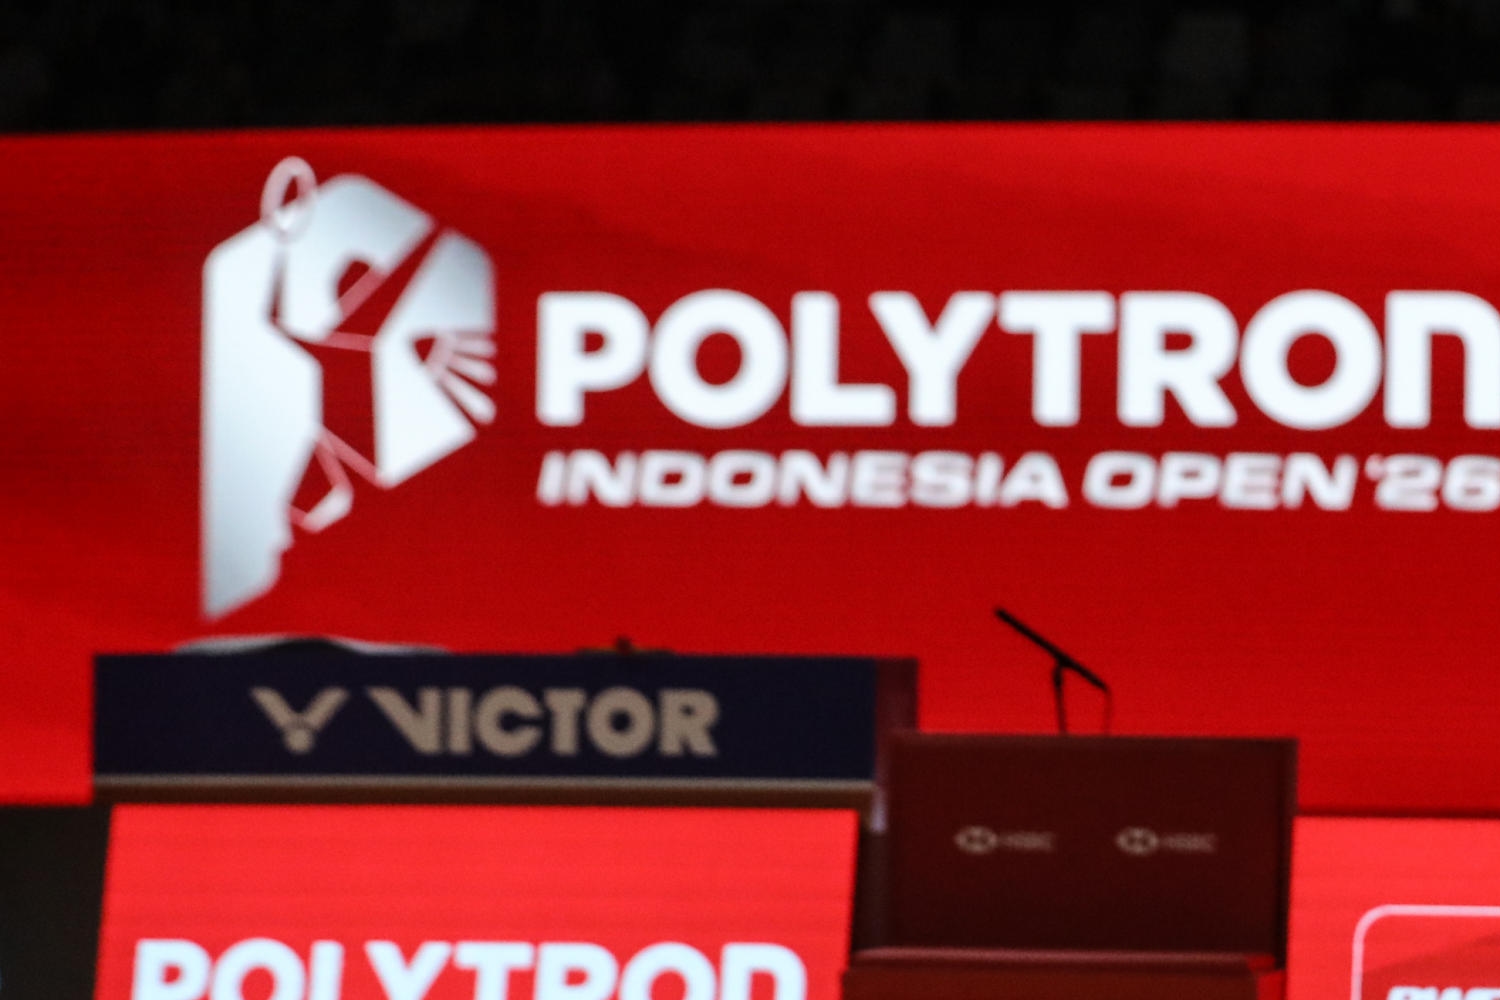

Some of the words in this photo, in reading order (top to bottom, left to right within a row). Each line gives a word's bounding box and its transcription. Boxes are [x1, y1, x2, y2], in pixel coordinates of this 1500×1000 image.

[537, 449, 1068, 508] INDONESIA
[1082, 452, 1358, 510] OPEN
[368, 686, 720, 757] VICTOR
